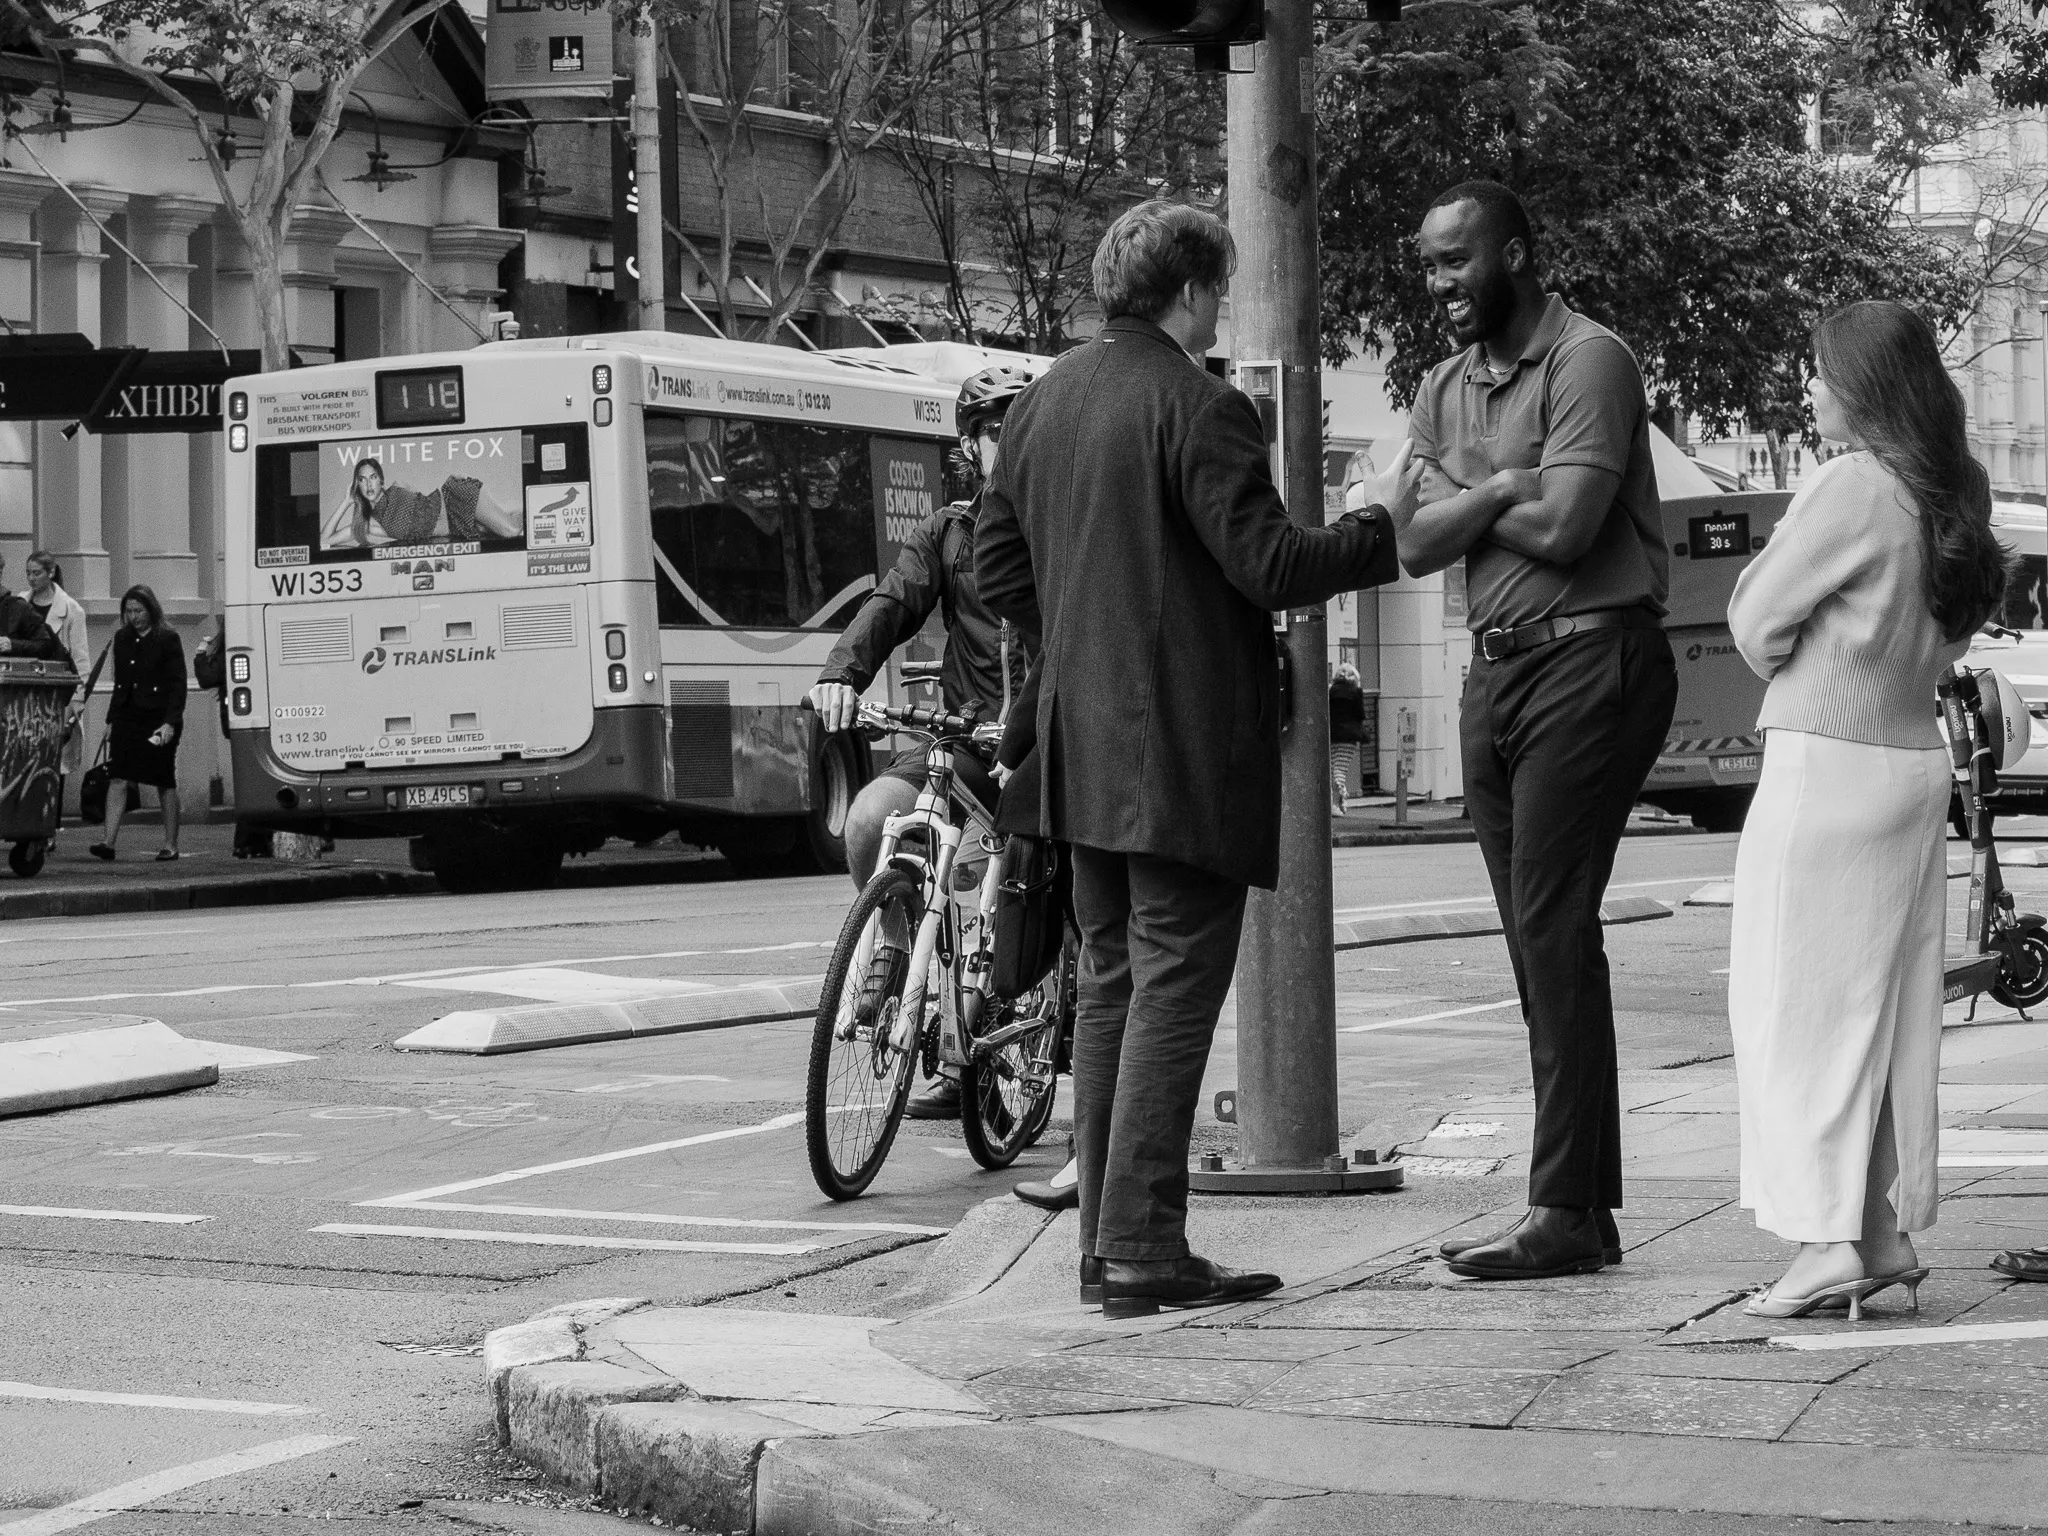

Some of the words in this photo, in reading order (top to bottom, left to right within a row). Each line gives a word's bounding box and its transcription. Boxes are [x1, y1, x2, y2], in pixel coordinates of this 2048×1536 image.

[301, 390, 349, 400] VOLGREN
[352, 389, 369, 397] BUS
[726, 387, 795, 407] www.translink.com.au
[267, 414, 309, 425] BRISBANE
[312, 411, 361, 421] TRANSPORT
[913, 399, 942, 423] WI353
[277, 426, 295, 435] BUS
[297, 422, 352, 433] WORKSHOPS
[337, 441, 433, 467] WHITE
[448, 437, 503, 460] FOX
[889, 459, 925, 488] COSTCO
[884, 487, 895, 514] IS
[894, 488, 918, 516] NOW
[918, 490, 933, 517] ON
[562, 507, 587, 517] GIVE
[563, 517, 586, 526] WAY
[1710, 536, 1722, 549] 30
[374, 543, 450, 559] EMERGENCY
[452, 541, 480, 554] EXIT
[391, 558, 455, 576] MAN
[530, 565, 547, 575] IT'S
[548, 564, 566, 573] THE
[567, 562, 588, 572] LAW
[271, 568, 363, 597] WI353
[392, 646, 497, 666] TRANSLink
[275, 706, 325, 718] Q100922
[279, 733, 292, 744] 13
[296, 732, 309, 743] 12
[312, 731, 327, 742] 30
[394, 738, 406, 747] 90
[411, 735, 442, 746] SPEED
[447, 733, 485, 743] LIMITED
